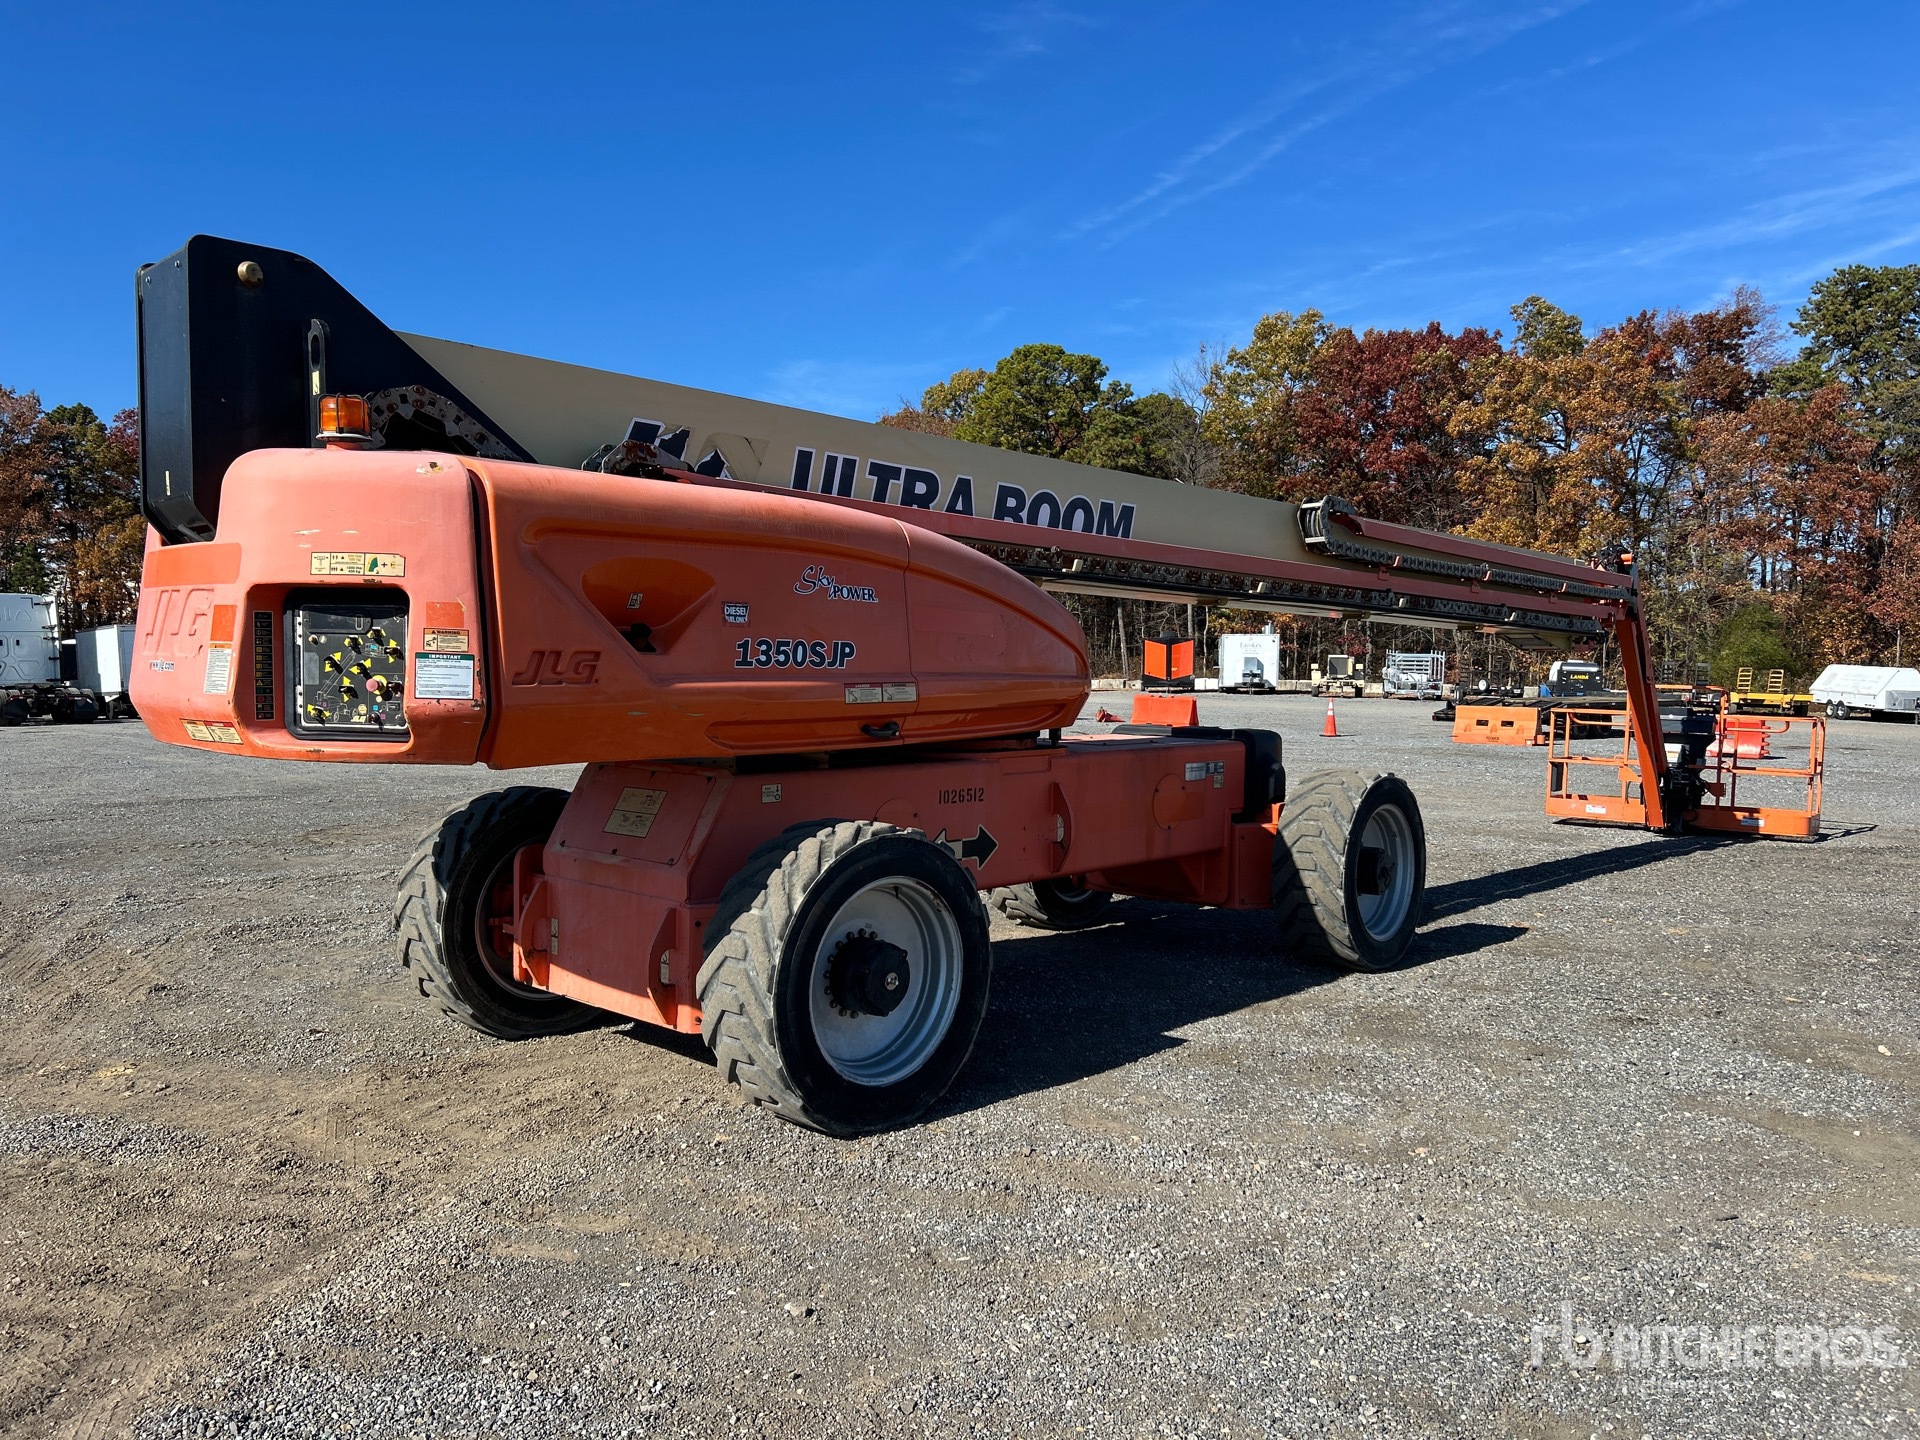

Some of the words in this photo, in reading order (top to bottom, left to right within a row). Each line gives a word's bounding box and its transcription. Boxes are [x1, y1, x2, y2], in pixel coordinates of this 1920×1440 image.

[992, 481, 1137, 540] BOOM
[793, 565, 835, 600] Sky
[831, 585, 878, 603] POWER
[724, 607, 746, 615] DIESEL
[511, 650, 601, 687] JLG
[734, 637, 857, 669] 1350SJP
[938, 787, 984, 804] 1026512
